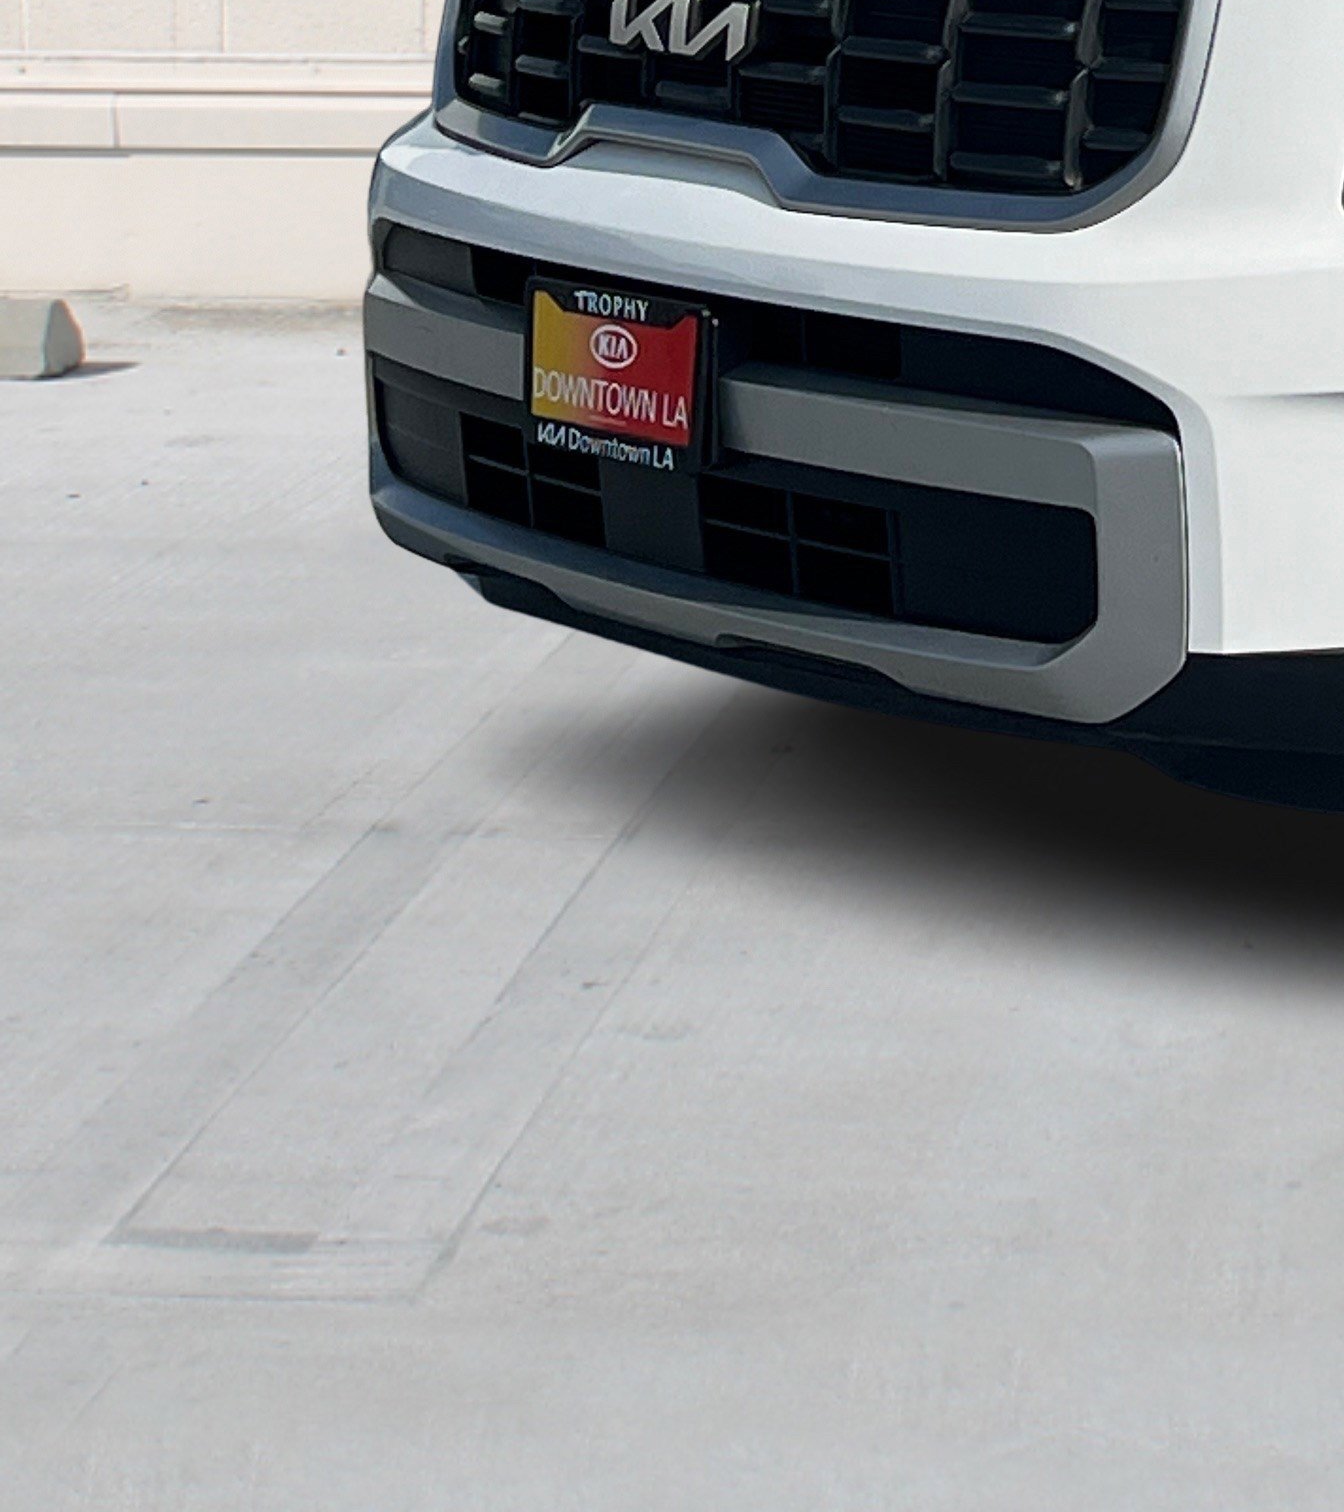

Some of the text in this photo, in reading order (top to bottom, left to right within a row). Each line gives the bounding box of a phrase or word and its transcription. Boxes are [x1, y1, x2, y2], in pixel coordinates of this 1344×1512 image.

[573, 289, 649, 322] TROPHY
[598, 333, 629, 361] KIA
[532, 367, 689, 430] DOWNTOWN LA
[568, 426, 651, 466] Downtown
[652, 444, 675, 472] LA
